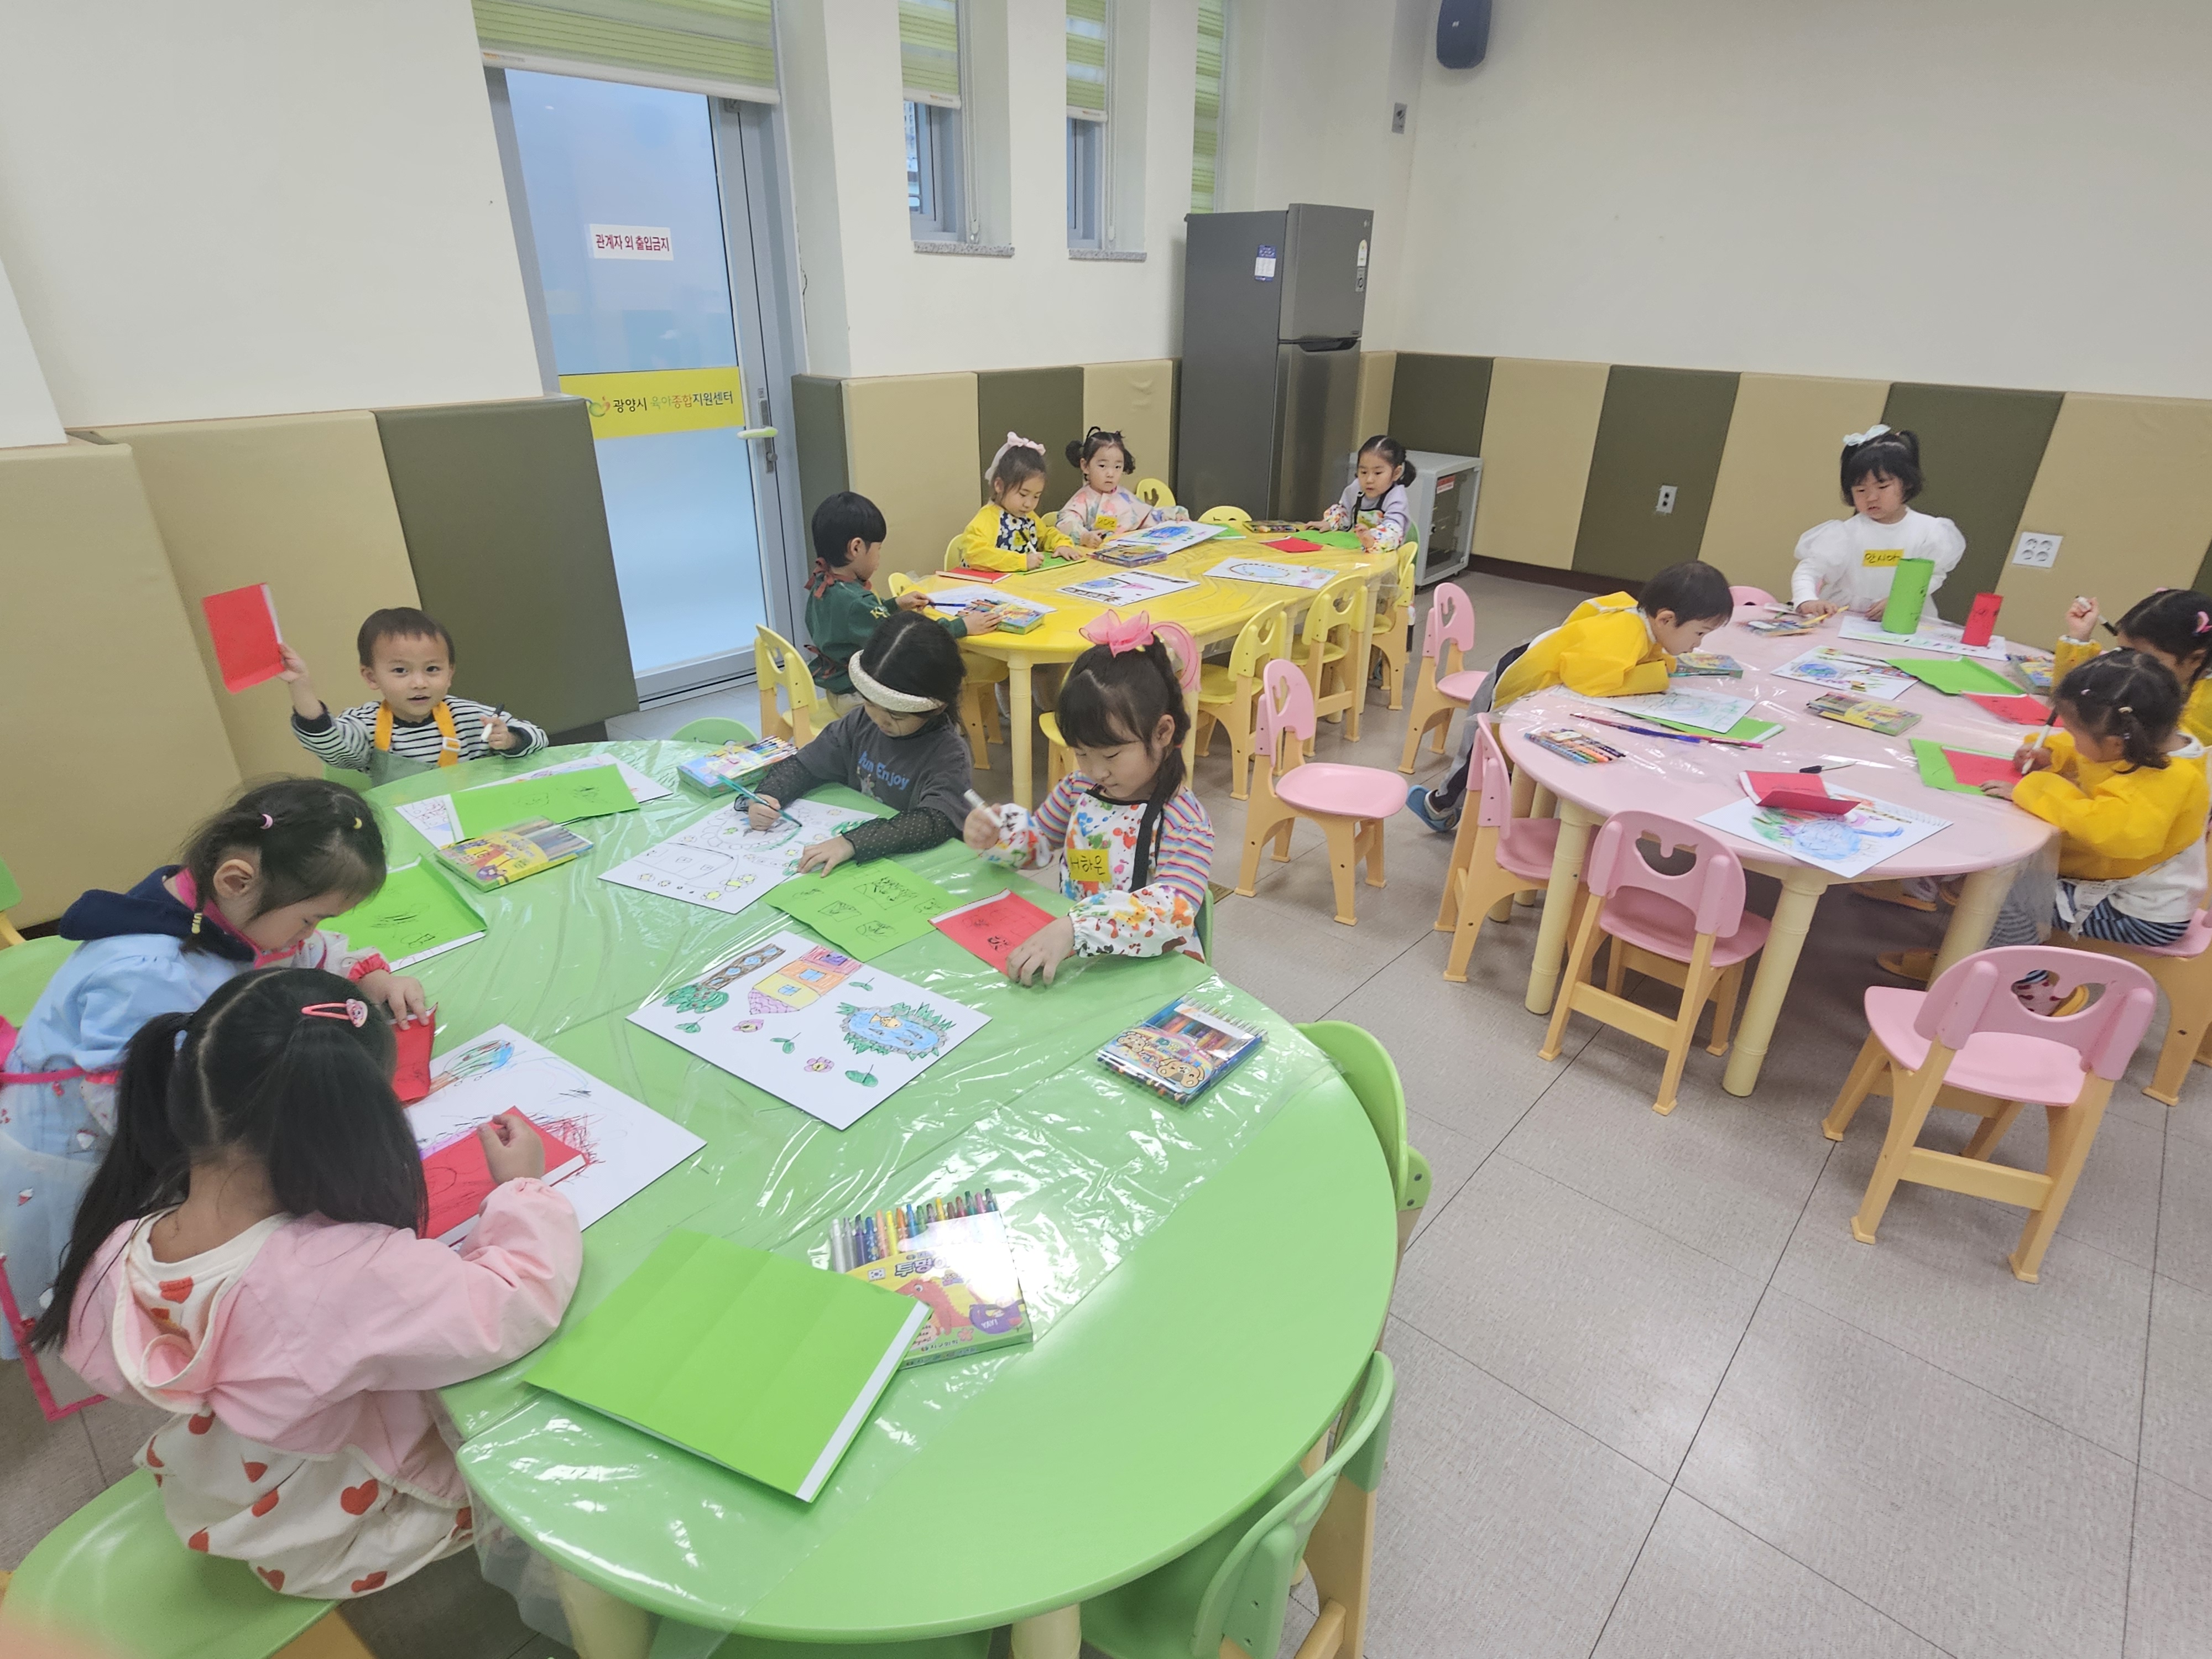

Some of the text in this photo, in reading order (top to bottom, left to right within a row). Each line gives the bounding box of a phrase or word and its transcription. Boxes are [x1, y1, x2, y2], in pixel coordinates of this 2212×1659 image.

[596, 234, 670, 252] 관계자 외 출입금지
[613, 390, 733, 413] 광양시 육아종합지원센터
[876, 762, 910, 791] Enjoy
